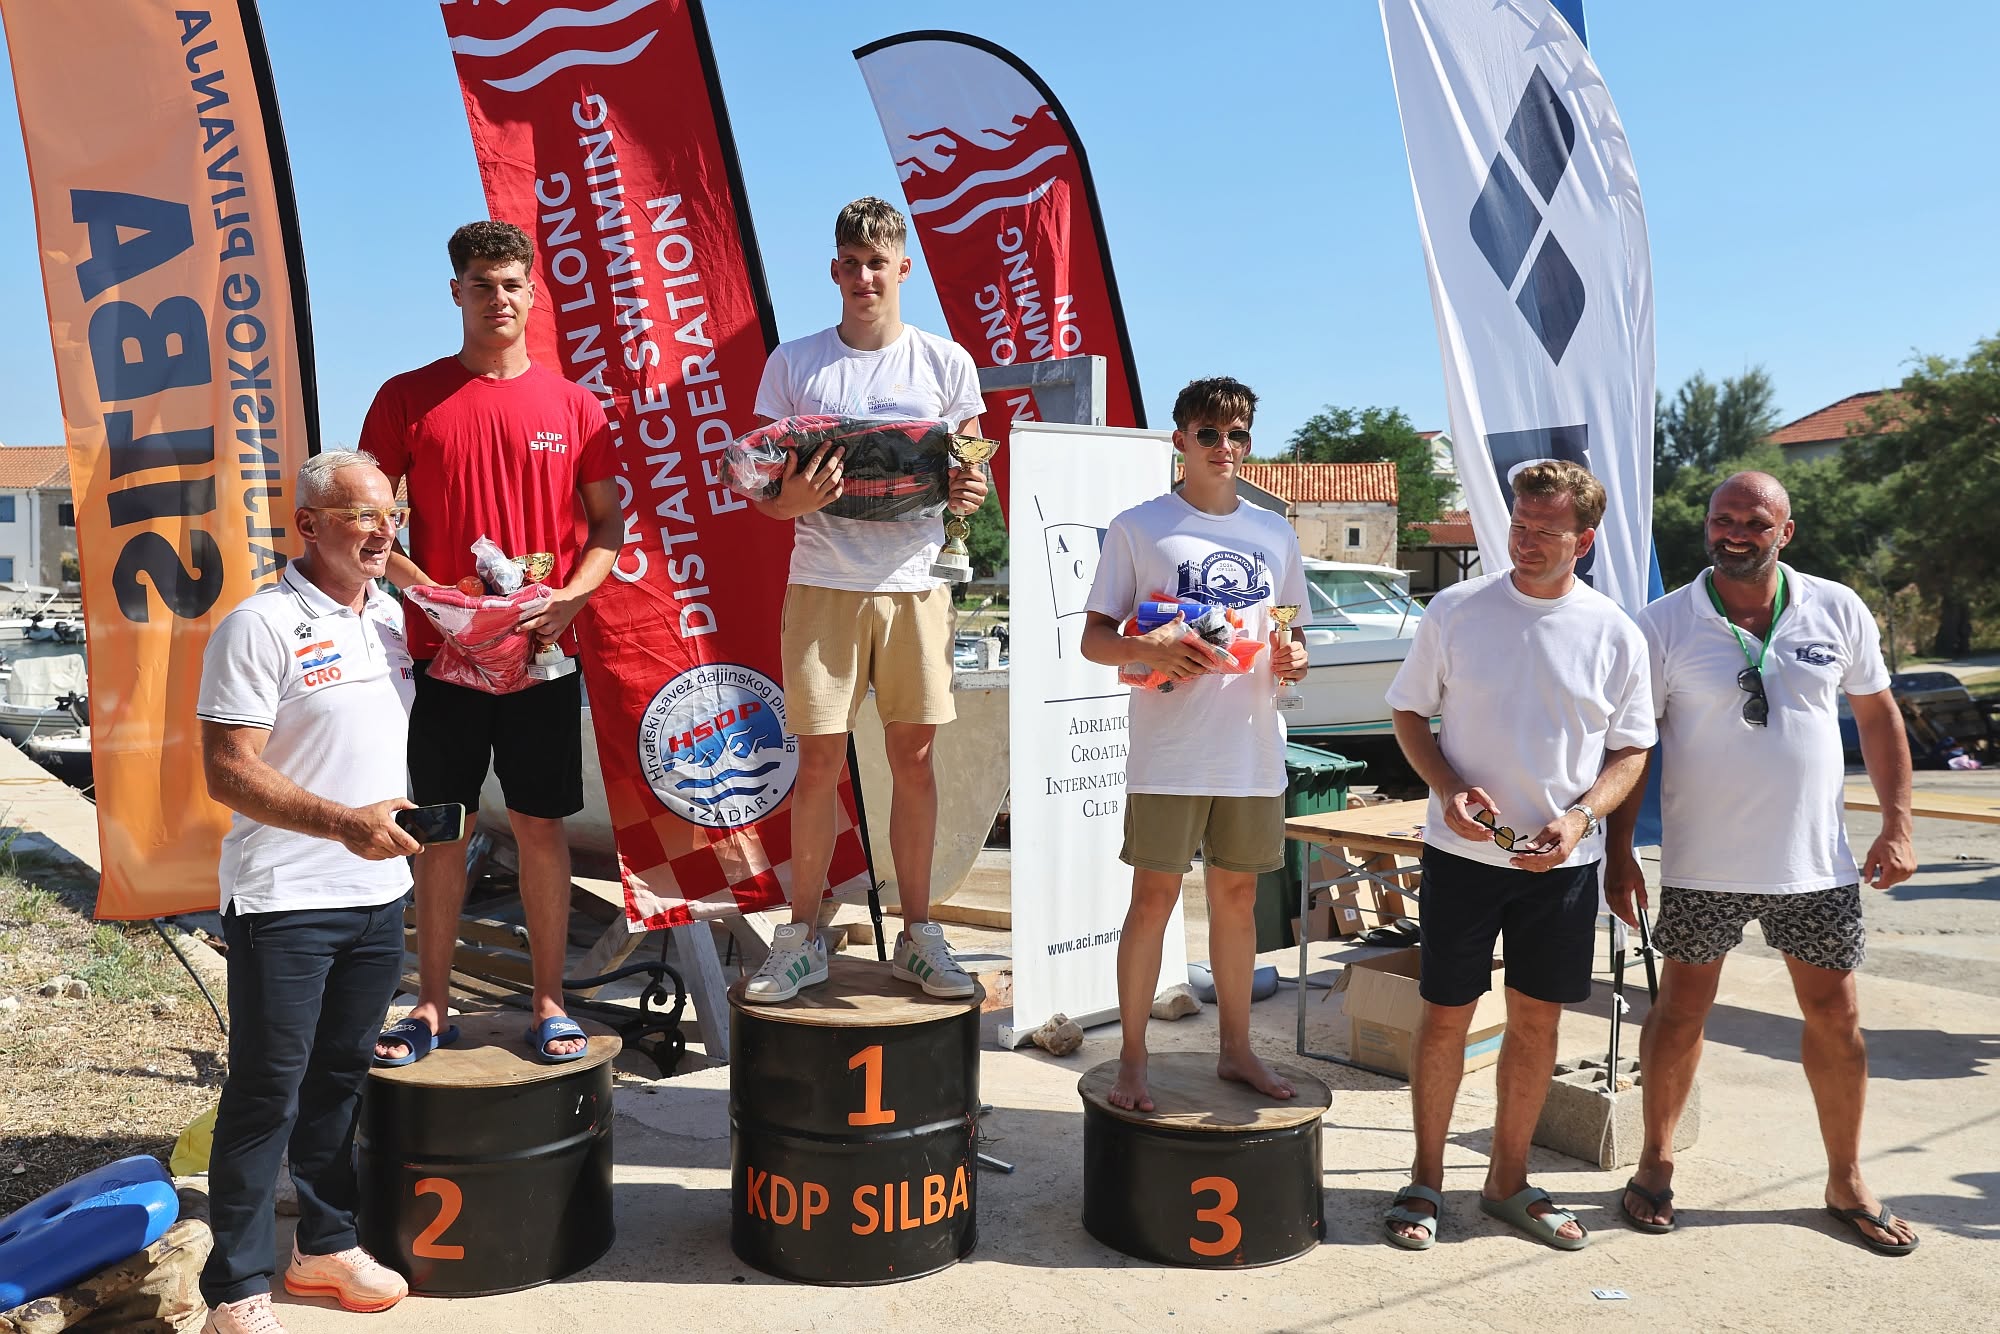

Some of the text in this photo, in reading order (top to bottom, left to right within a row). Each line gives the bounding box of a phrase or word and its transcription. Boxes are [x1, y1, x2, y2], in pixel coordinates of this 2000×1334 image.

[535, 171, 648, 583] CROAN LONG
[572, 93, 718, 639] DISTANCE SWIMMING
[530, 441, 568, 454] SPLIT
[536, 431, 563, 442] KDP
[1224, 553, 1252, 571] MARATON
[303, 666, 342, 687] CRO
[643, 715, 663, 782] Hrvatski
[656, 679, 694, 715] savez
[697, 668, 772, 699] daljinskog
[668, 701, 762, 753] HSDP
[699, 795, 768, 822] ZADAR
[1045, 771, 1126, 795] INTERNATIO
[847, 1045, 895, 1126] 1
[412, 1177, 465, 1261] 2
[747, 1165, 968, 1236] KDP SILBA
[1189, 1176, 1242, 1257] 3
